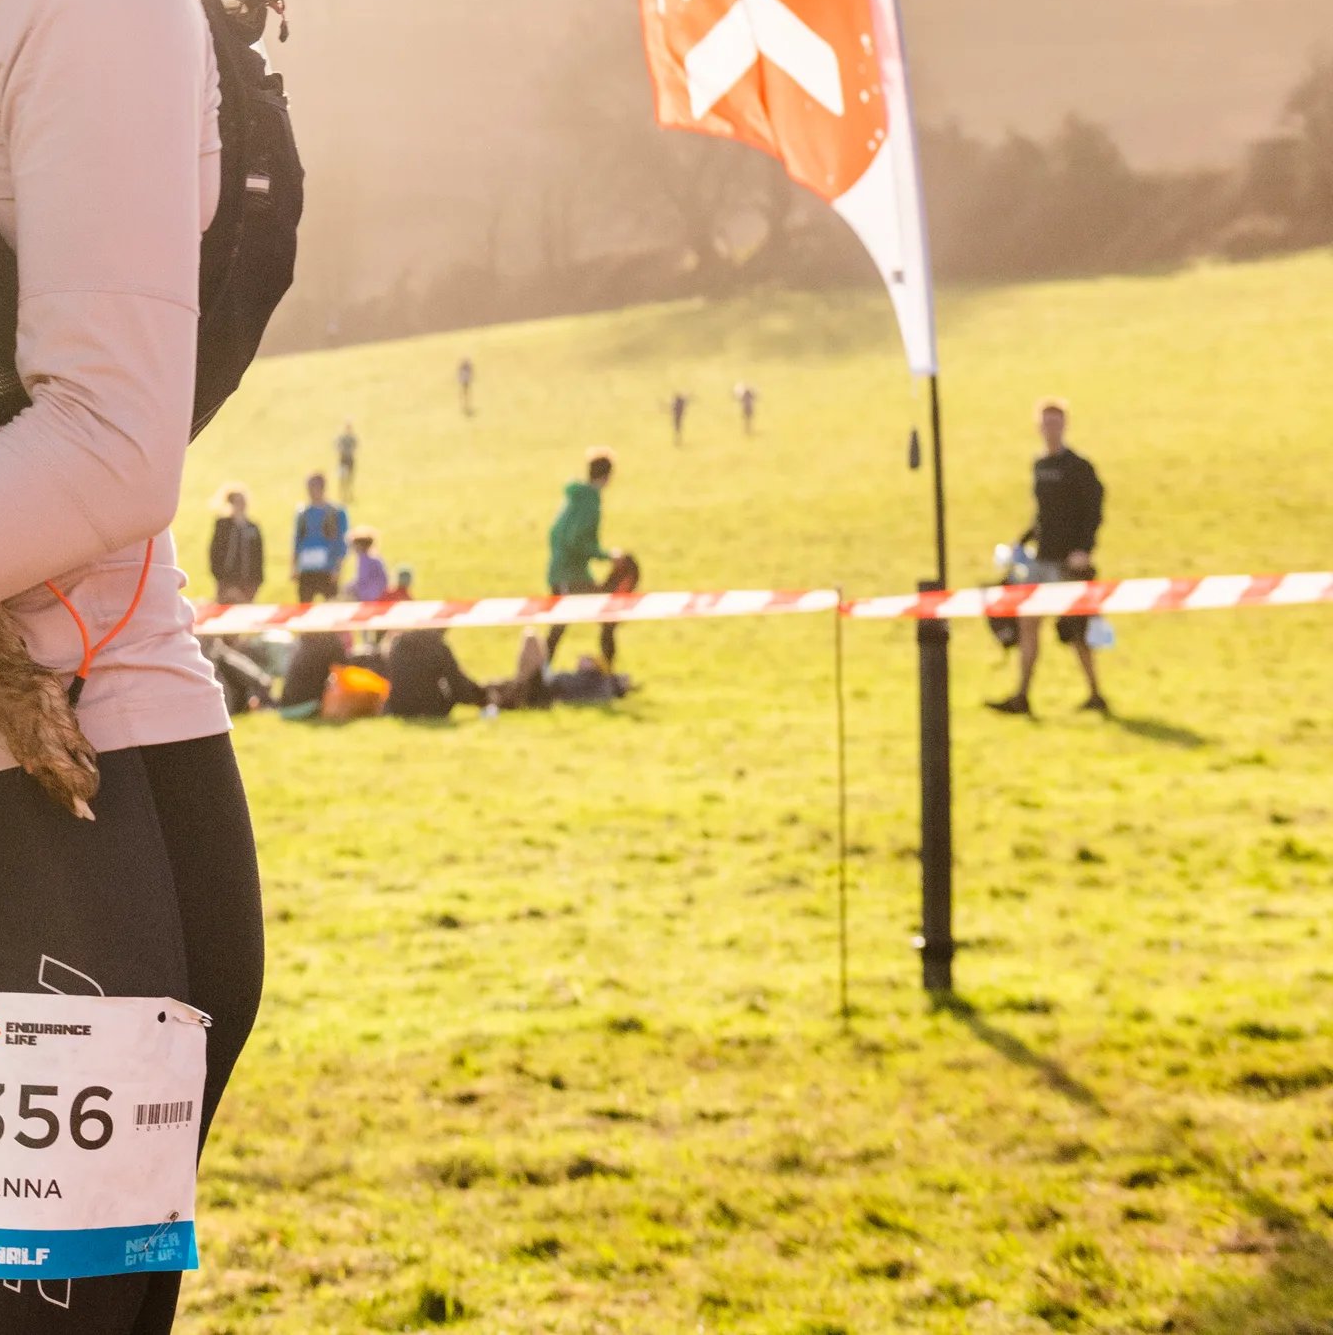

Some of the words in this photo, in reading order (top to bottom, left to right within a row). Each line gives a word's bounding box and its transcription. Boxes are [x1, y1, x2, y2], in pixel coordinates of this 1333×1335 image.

[5, 1021, 92, 1036] ENDURANCE
[5, 1033, 37, 1046] LIFE
[125, 1232, 180, 1254] NEVER
[125, 1250, 155, 1267] GIVE
